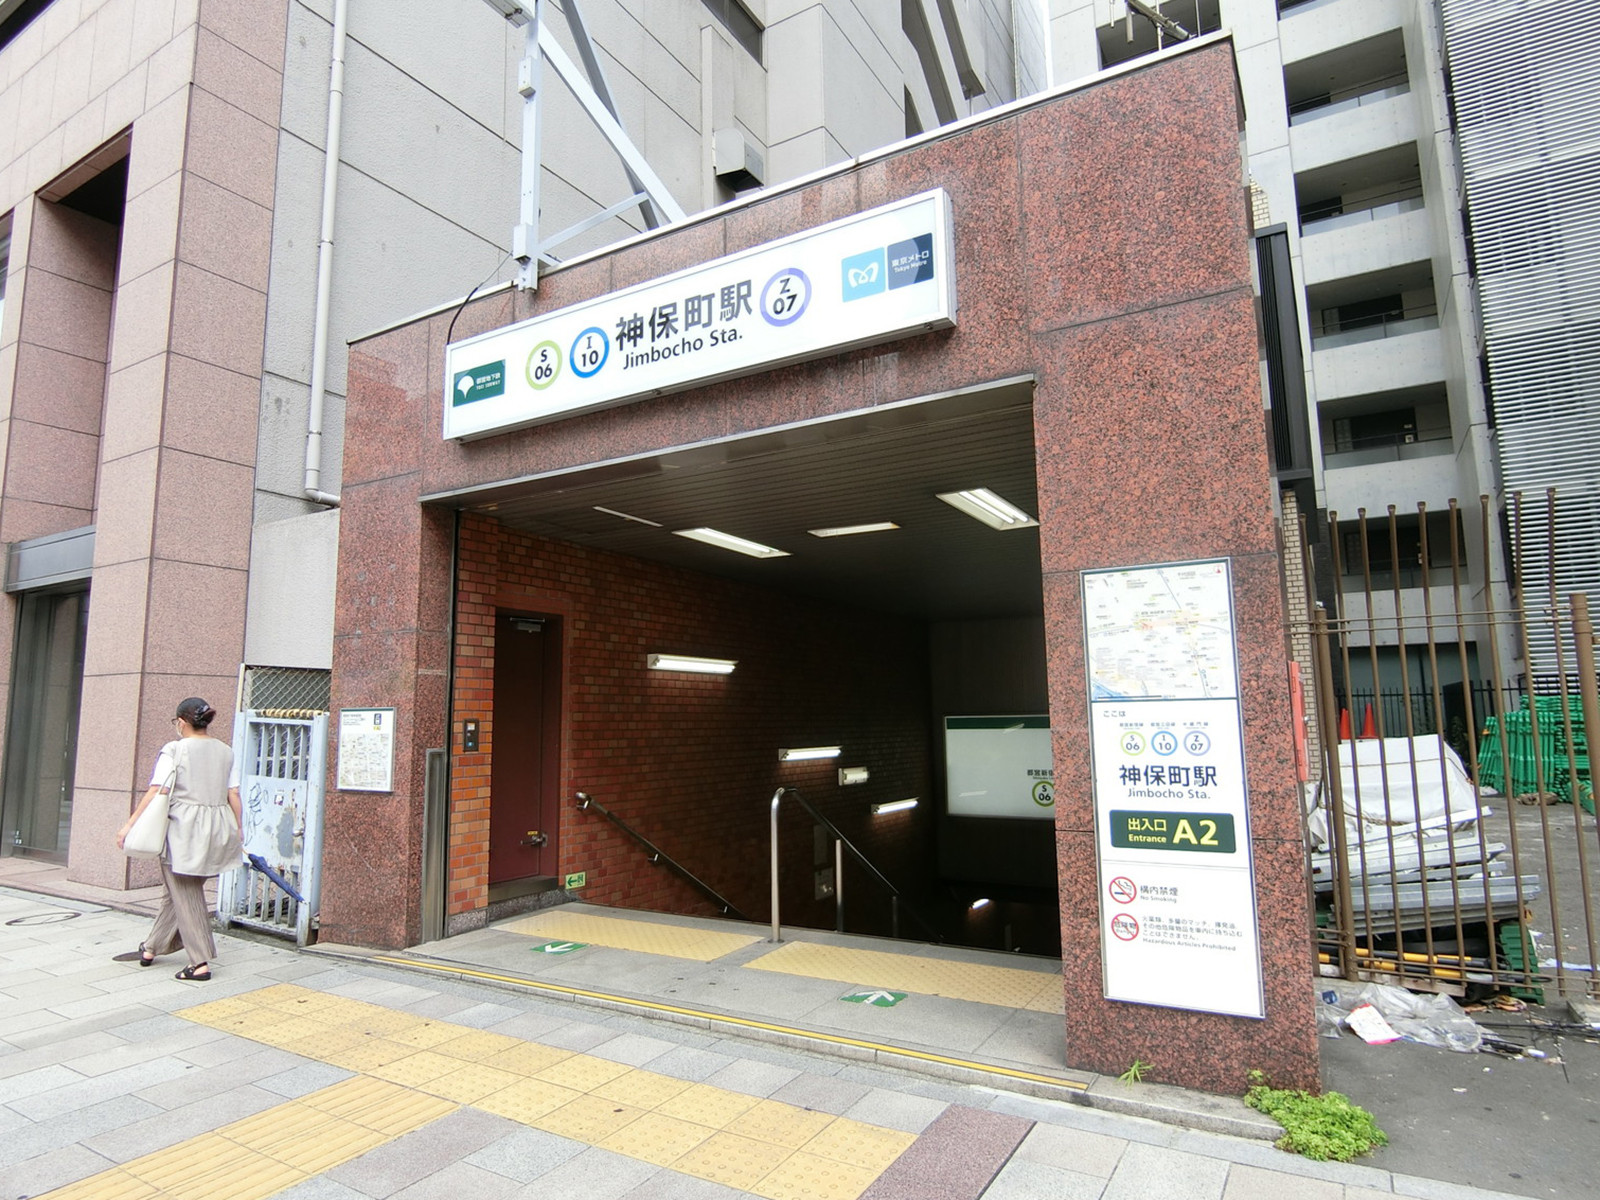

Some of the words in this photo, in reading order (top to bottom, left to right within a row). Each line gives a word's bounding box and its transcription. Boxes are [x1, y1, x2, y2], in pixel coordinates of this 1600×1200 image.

[891, 250, 929, 267] 東京メトロ
[779, 277, 791, 295] Z
[772, 293, 798, 315] 07
[615, 279, 753, 351] 神保町駅
[586, 335, 592, 350] I
[623, 337, 704, 370] Jimbocho
[709, 328, 743, 347] Sta.
[540, 349, 548, 363] S
[581, 350, 599, 367] 10
[534, 364, 553, 380] 06
[1103, 710, 1126, 718] ここは
[1130, 734, 1135, 742] S
[1161, 734, 1166, 742] I
[1193, 734, 1200, 742] Z
[1125, 742, 1140, 751] 06
[1158, 742, 1172, 751] 10
[1190, 742, 1204, 751] 07
[1119, 764, 1218, 788] 神保町駅
[1042, 784, 1048, 792] S
[1128, 787, 1184, 799] Jimbocho
[1187, 788, 1211, 800] Sta.
[1038, 793, 1051, 801] 06
[1127, 817, 1167, 832] 出入口
[1128, 833, 1167, 843] Entrance
[1172, 818, 1219, 846] A2
[1140, 885, 1178, 896] 構内禁煙
[1150, 896, 1177, 904] Smoking
[1142, 938, 1176, 947] Hazardous
[1176, 940, 1201, 949] Articles
[1202, 943, 1237, 952] Prohibited
